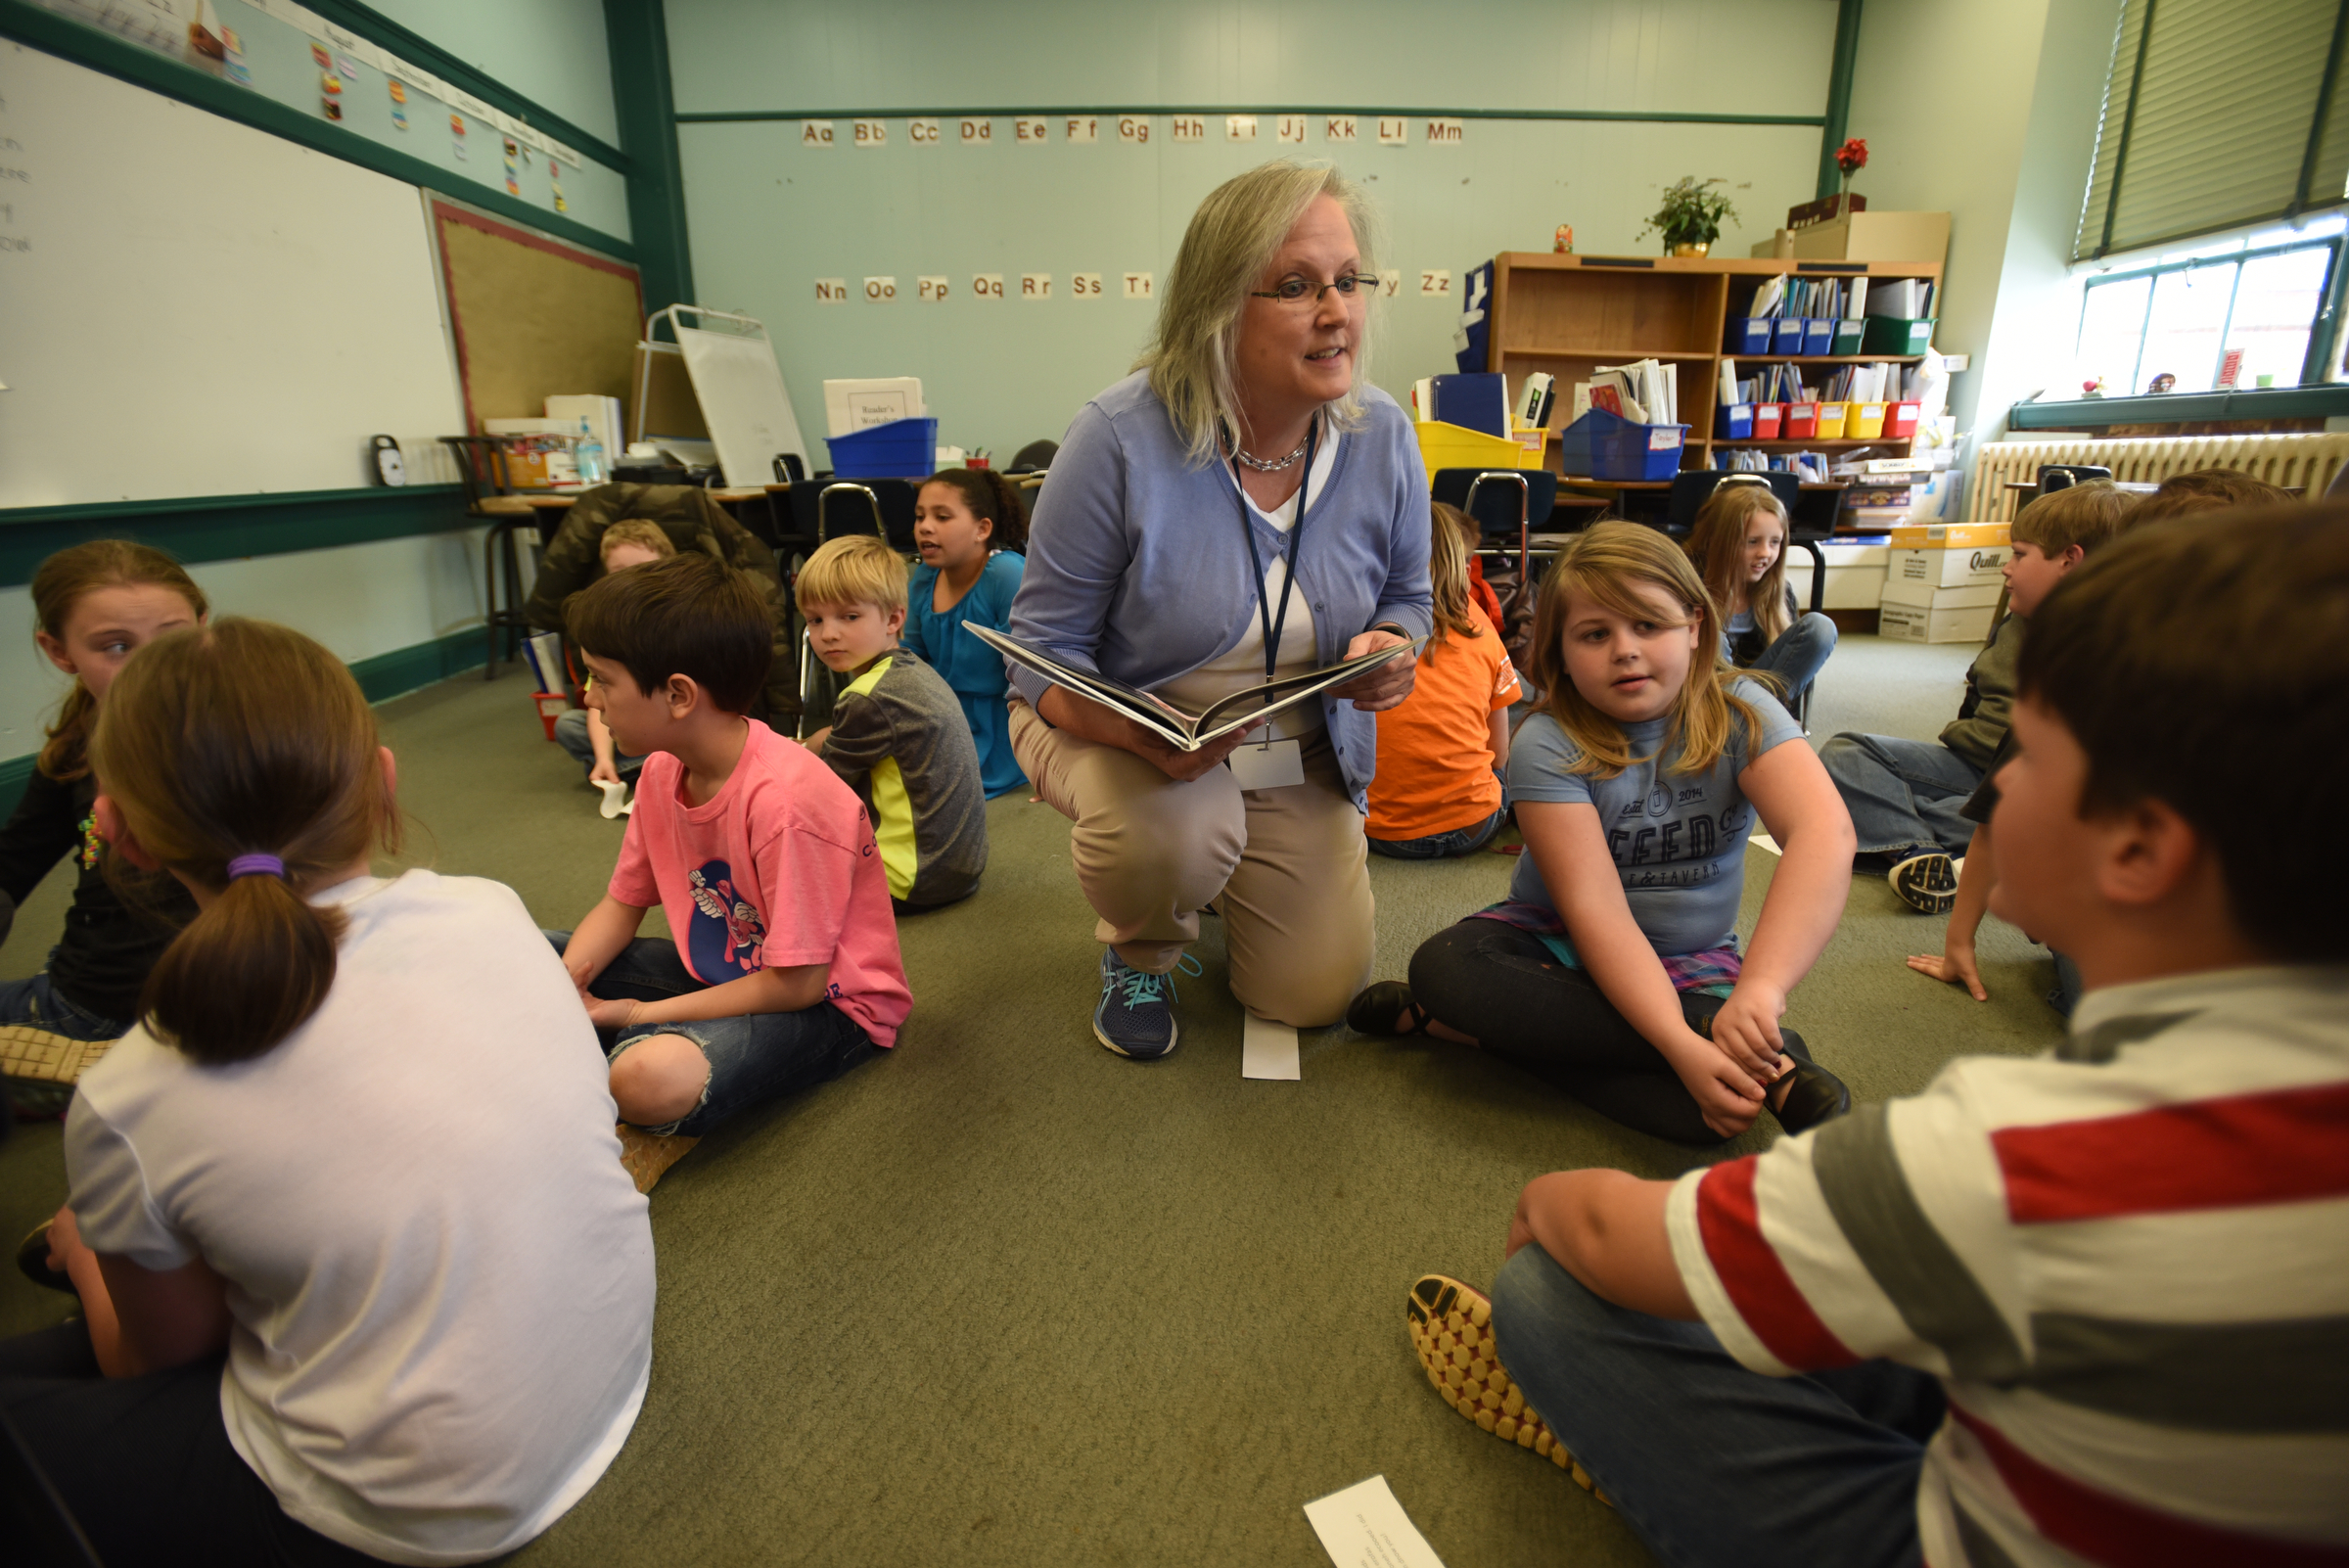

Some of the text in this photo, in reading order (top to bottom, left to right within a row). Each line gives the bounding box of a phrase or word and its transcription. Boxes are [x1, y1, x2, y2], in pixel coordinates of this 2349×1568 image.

[804, 123, 833, 142] Aa
[853, 123, 885, 140] Bb
[910, 122, 939, 141] Cc
[960, 121, 990, 139] Dd
[1015, 121, 1046, 139] Ee
[1119, 118, 1148, 143] Gg
[1174, 120, 1203, 137] Hh
[1328, 120, 1356, 137] Kk
[1428, 123, 1462, 139] Mm
[1970, 551, 2007, 572] Quill.c
[1679, 787, 1703, 802] 2014
[1662, 861, 1720, 884] TAVERN
